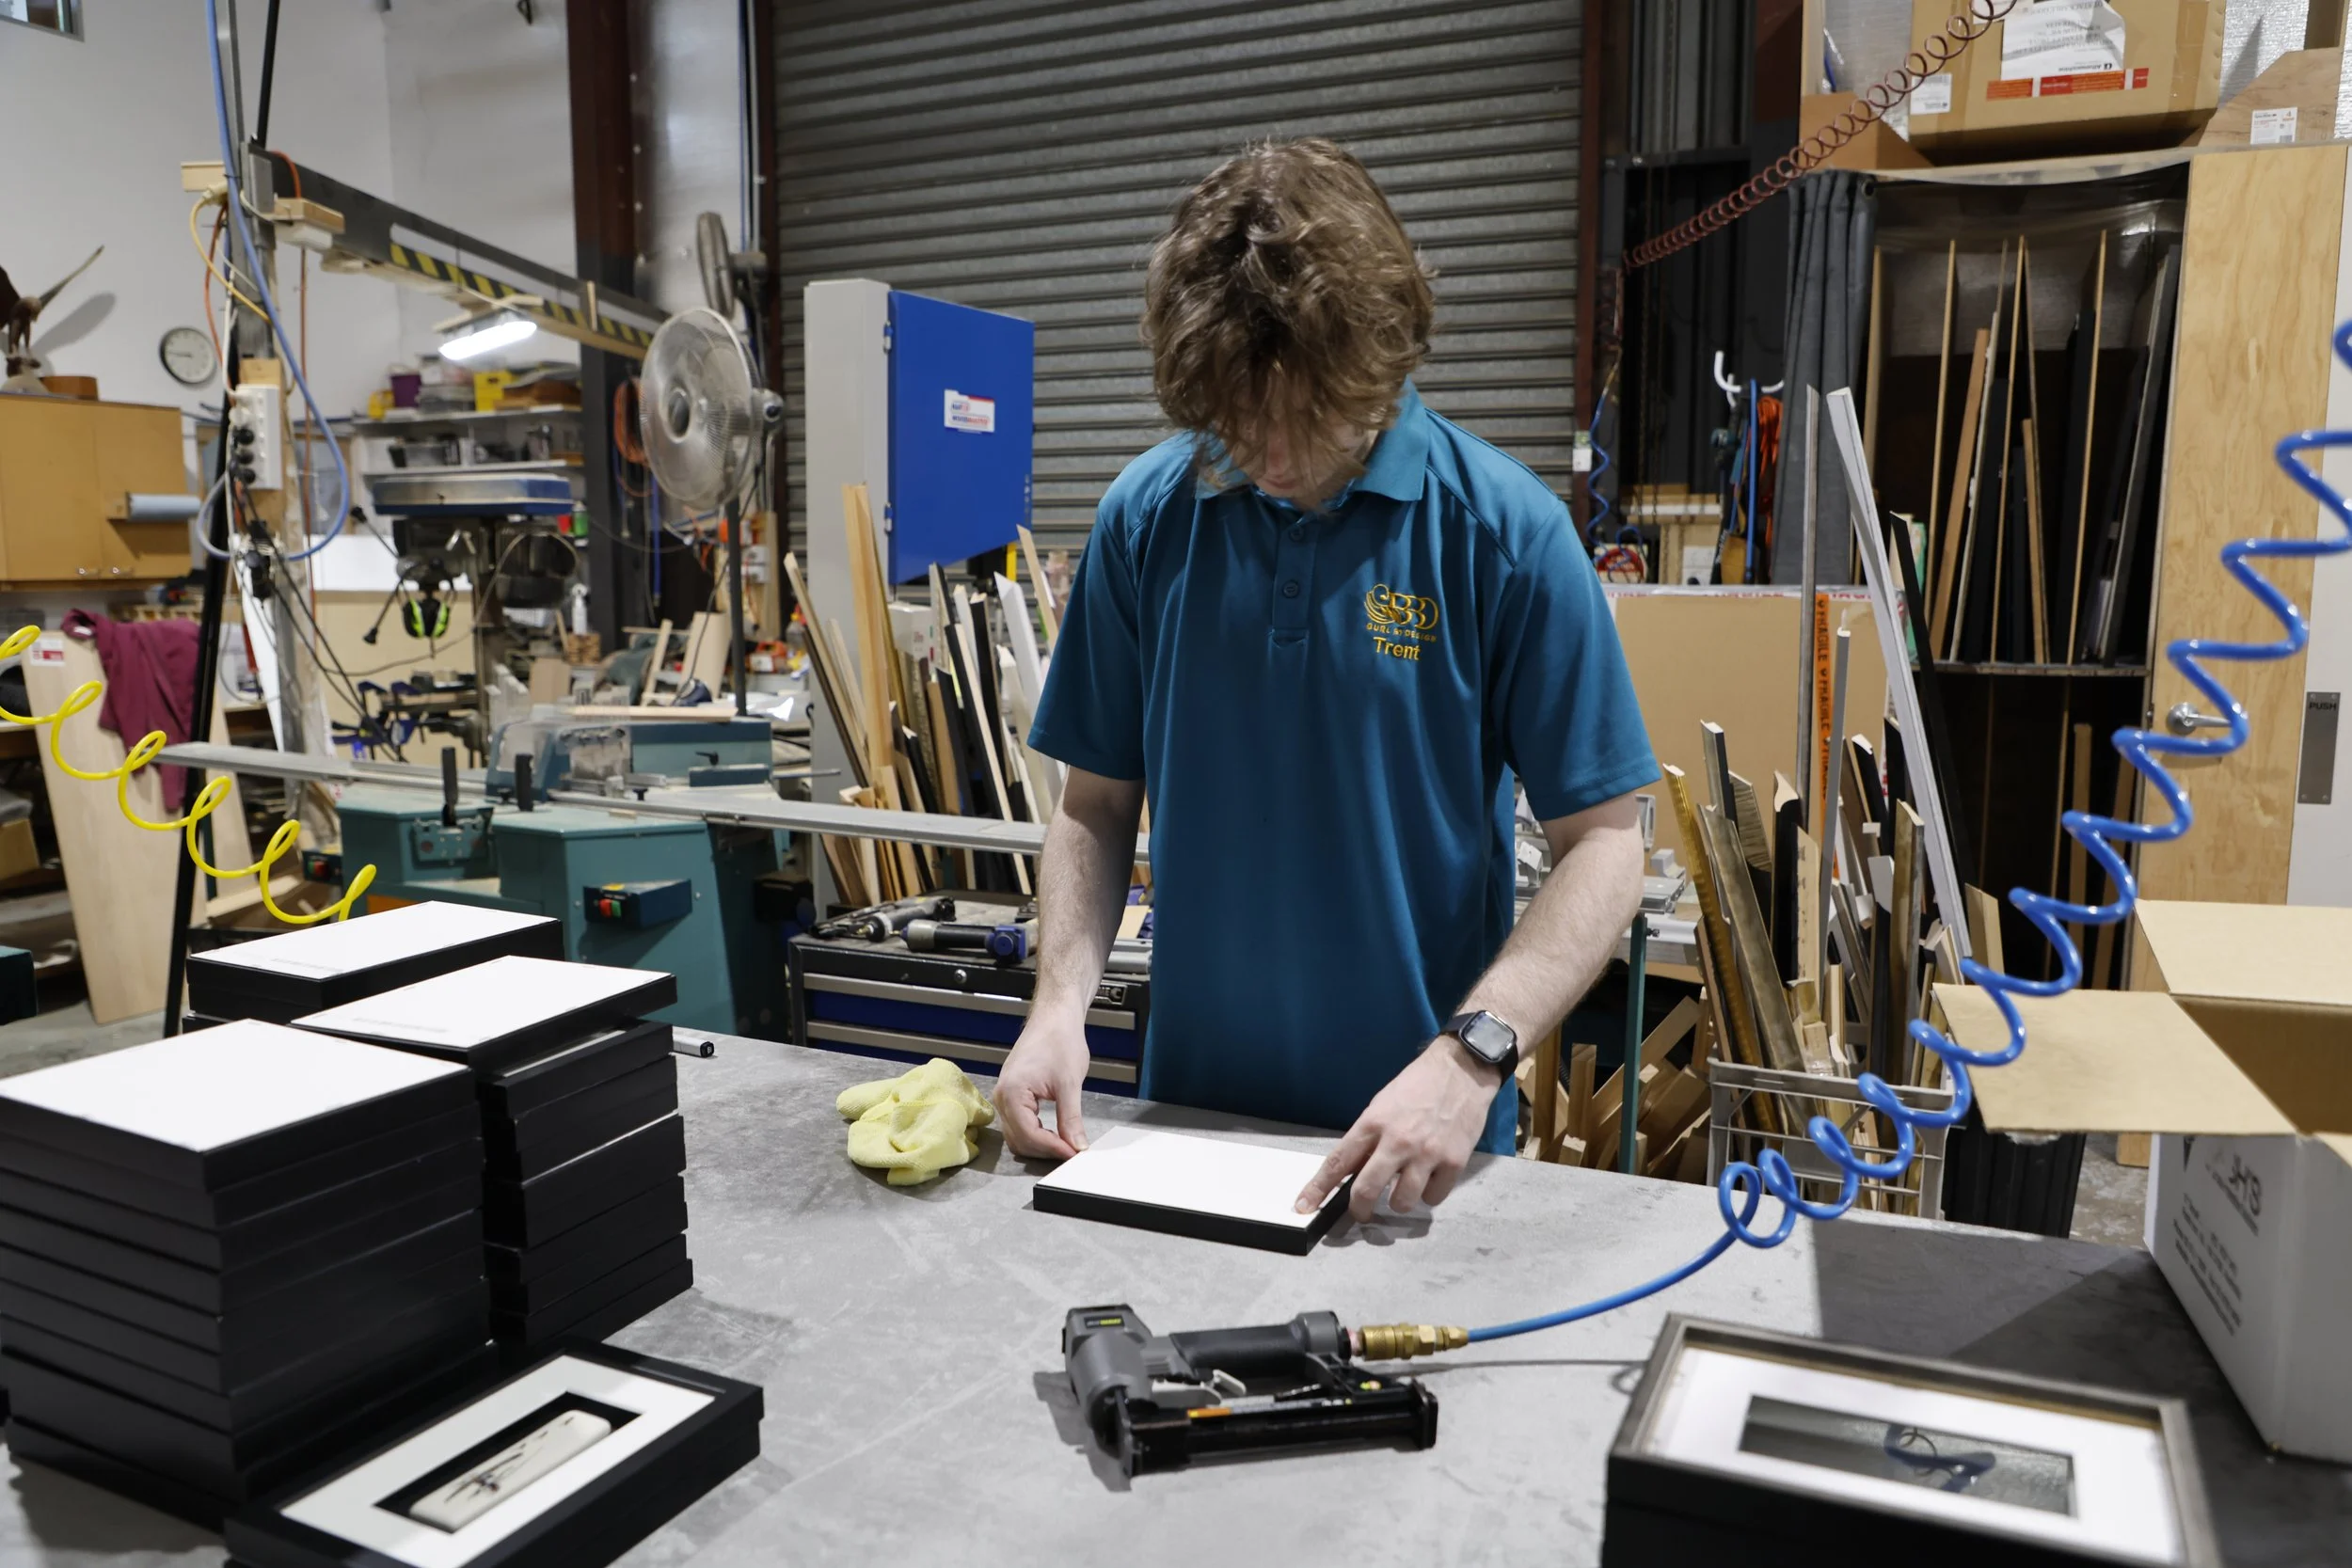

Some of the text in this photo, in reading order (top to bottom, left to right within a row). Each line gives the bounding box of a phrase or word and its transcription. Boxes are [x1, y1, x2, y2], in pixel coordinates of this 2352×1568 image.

[1373, 637, 1421, 660] Trent
[1817, 610, 1830, 662] FRAGILE
[1819, 679, 1831, 731] FRAGILE
[2309, 702, 2337, 711] PUSH
